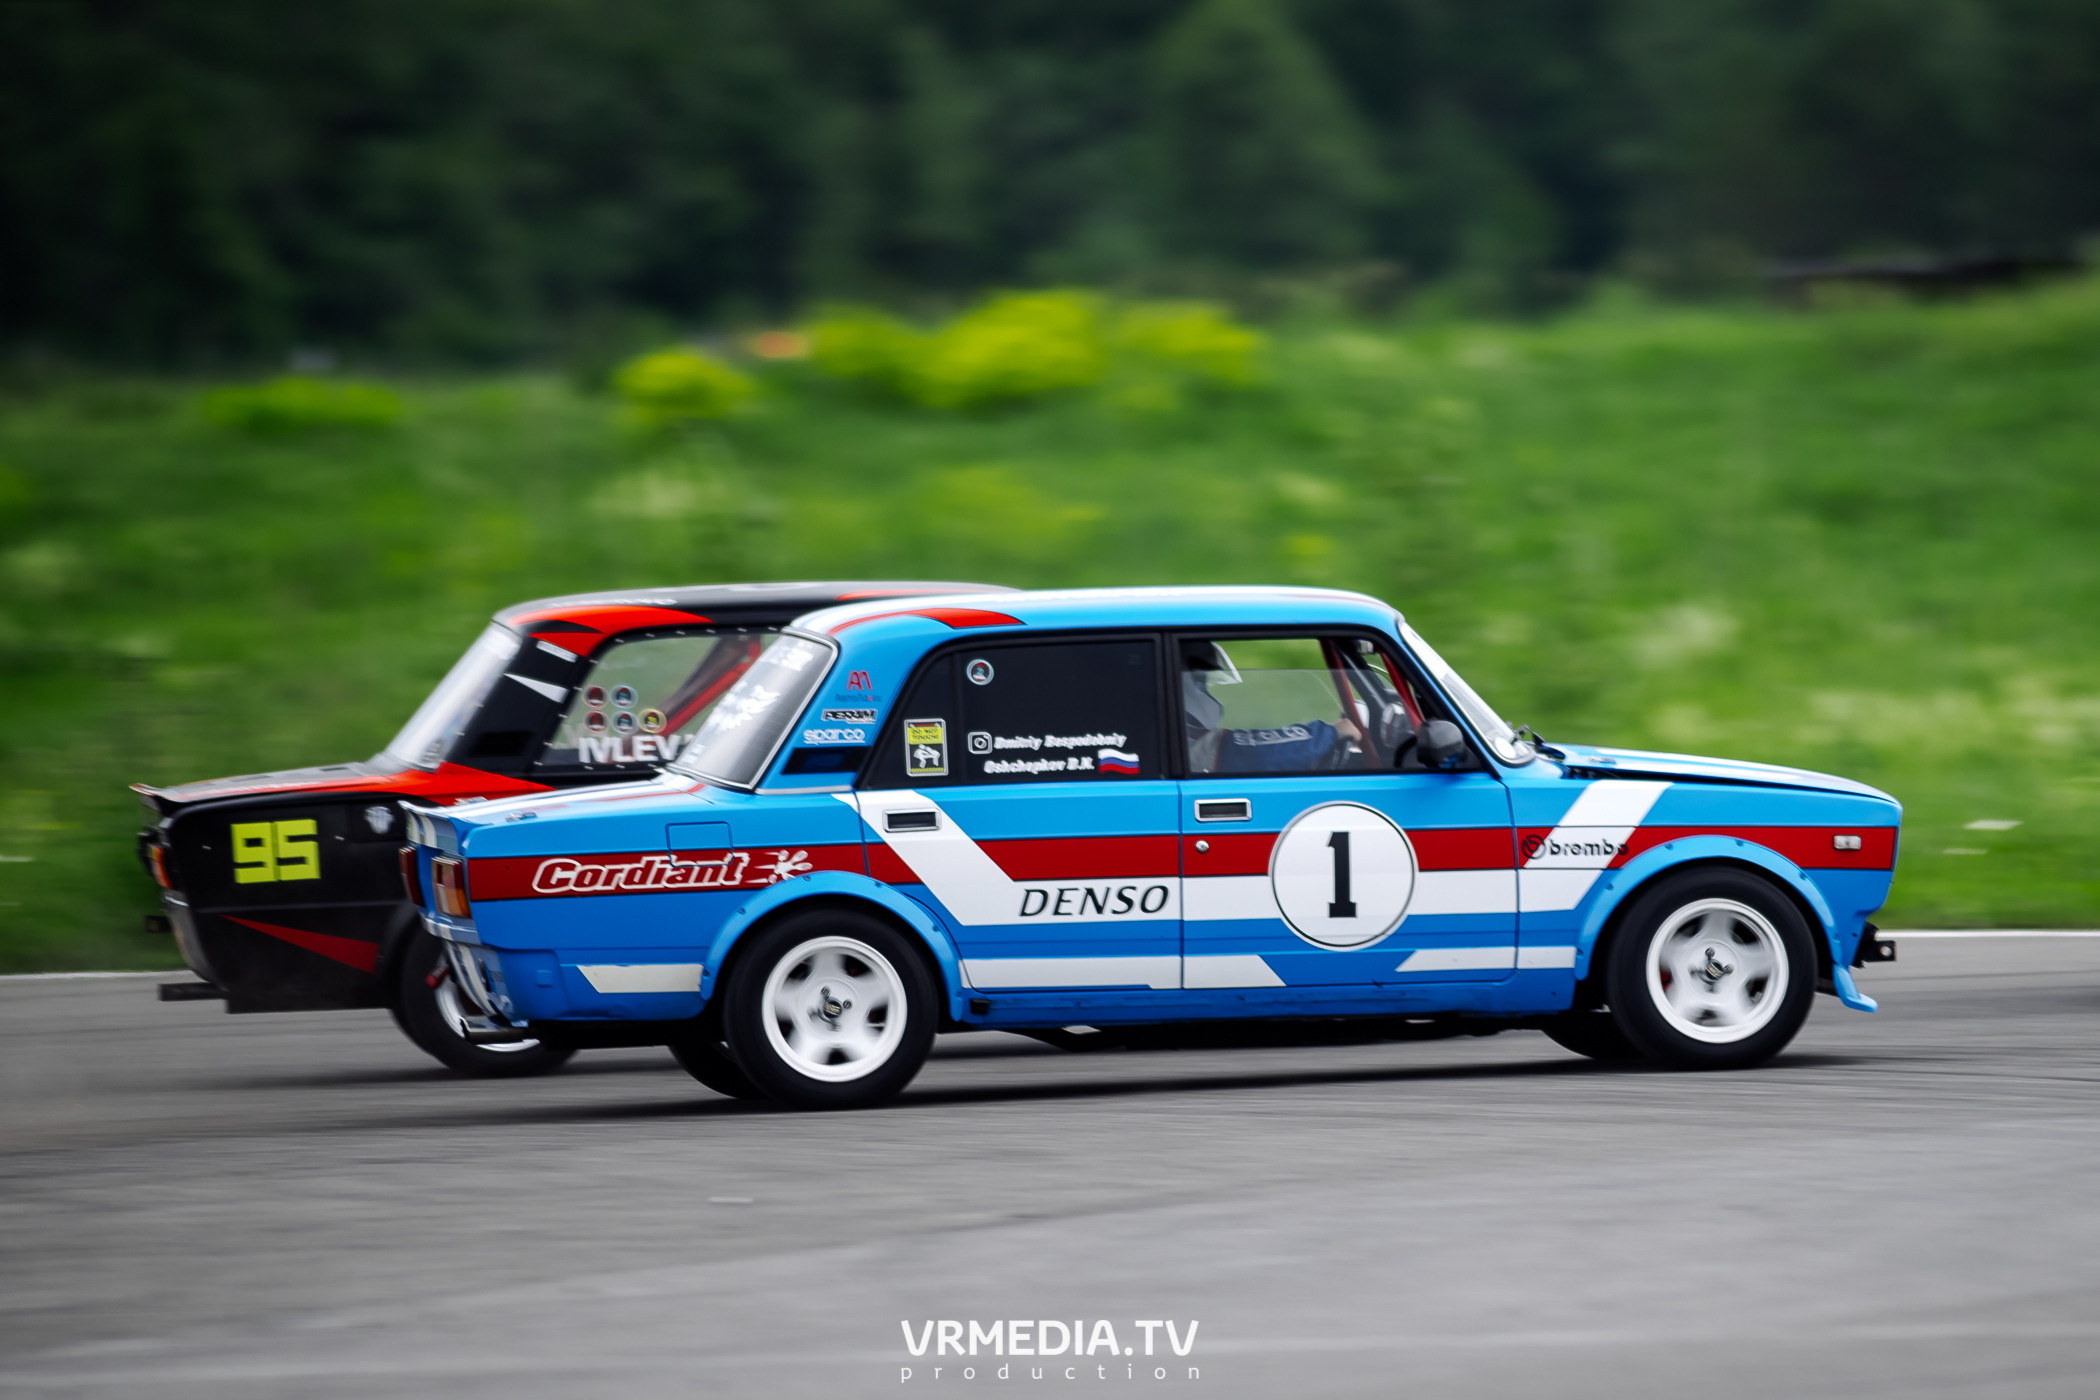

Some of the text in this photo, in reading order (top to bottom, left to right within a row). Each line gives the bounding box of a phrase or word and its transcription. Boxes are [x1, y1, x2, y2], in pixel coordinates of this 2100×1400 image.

[803, 728, 866, 745] sparco
[994, 736, 1042, 750] Dmitriy
[231, 819, 321, 883] 95
[1549, 839, 1629, 856] brembo
[532, 852, 750, 893] Cordiant
[1326, 831, 1357, 918] 1
[1019, 885, 1169, 917] DENSO
